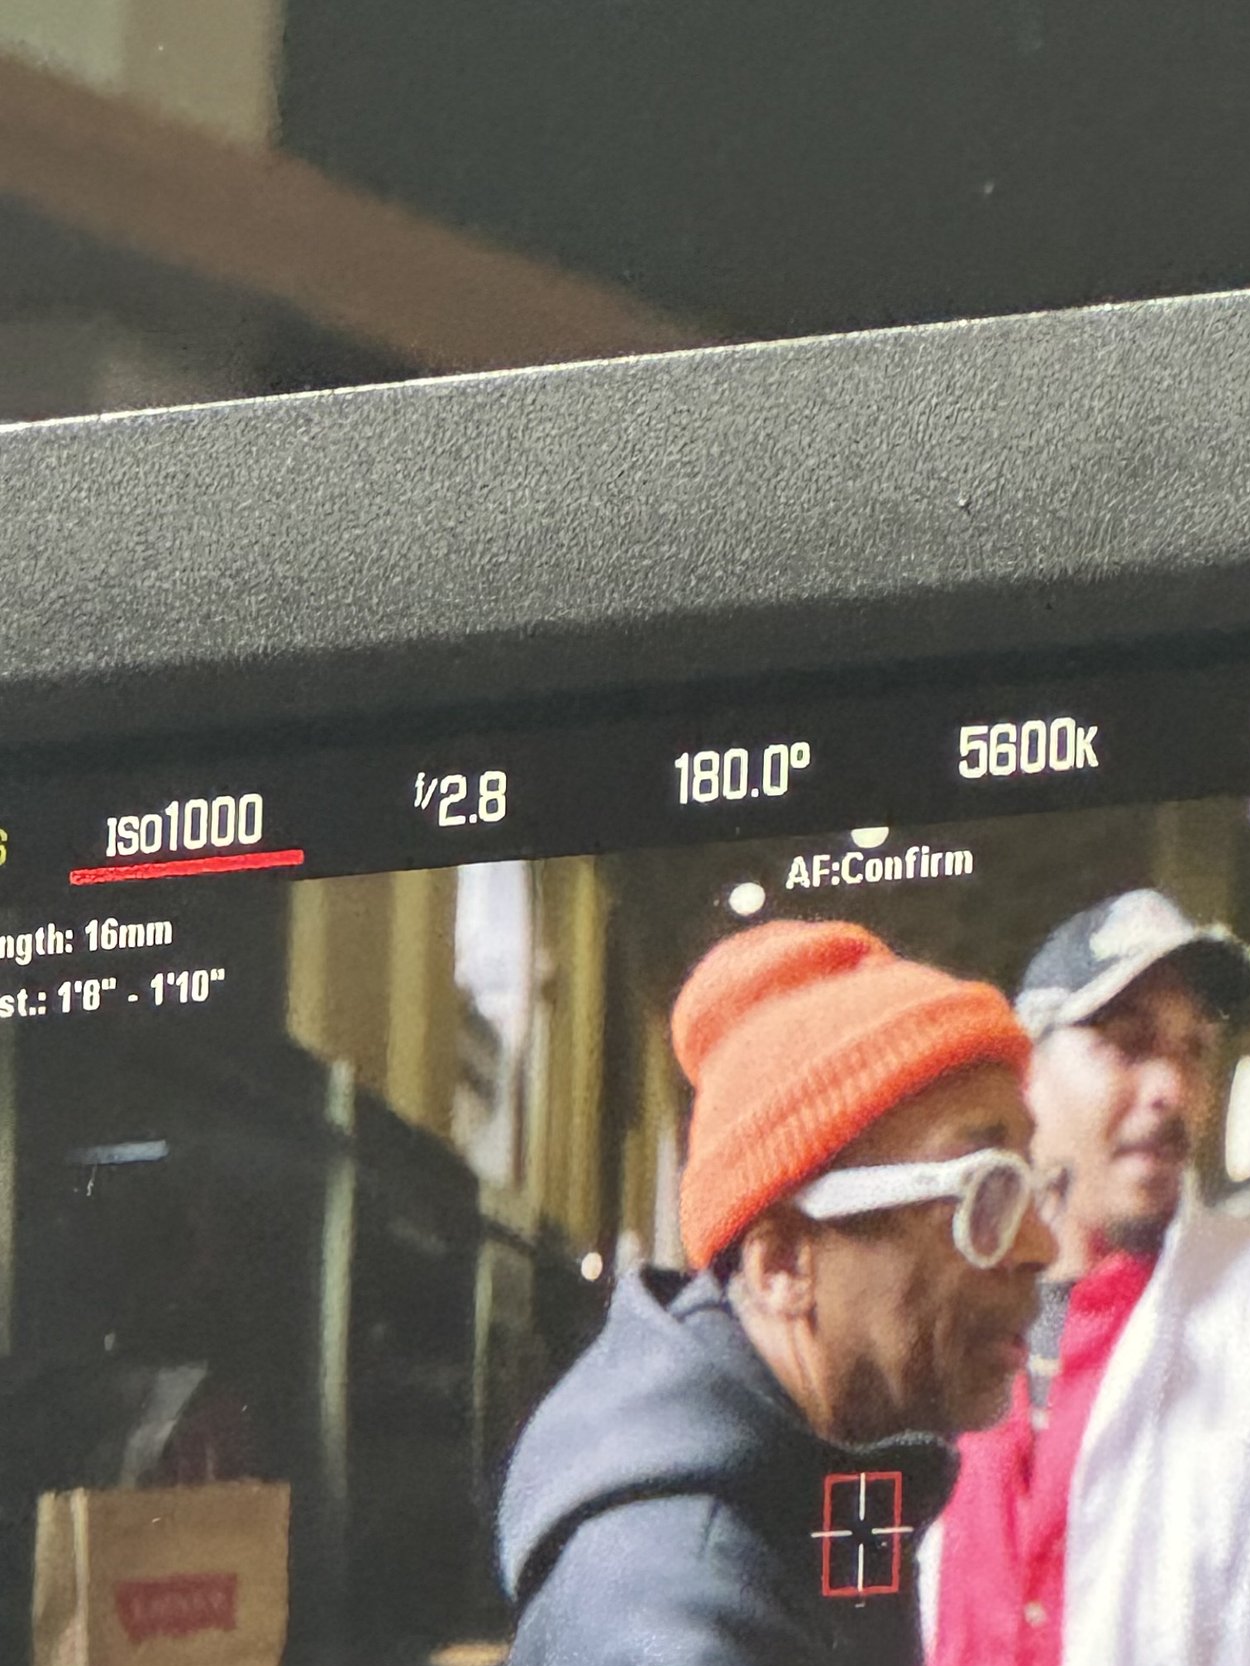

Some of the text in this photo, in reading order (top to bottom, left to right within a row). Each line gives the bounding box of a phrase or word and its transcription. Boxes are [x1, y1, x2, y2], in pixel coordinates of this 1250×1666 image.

[106, 793, 263, 857] ISO1000
[786, 847, 973, 889] AF:Confirm
[85, 918, 173, 952] 16mm
